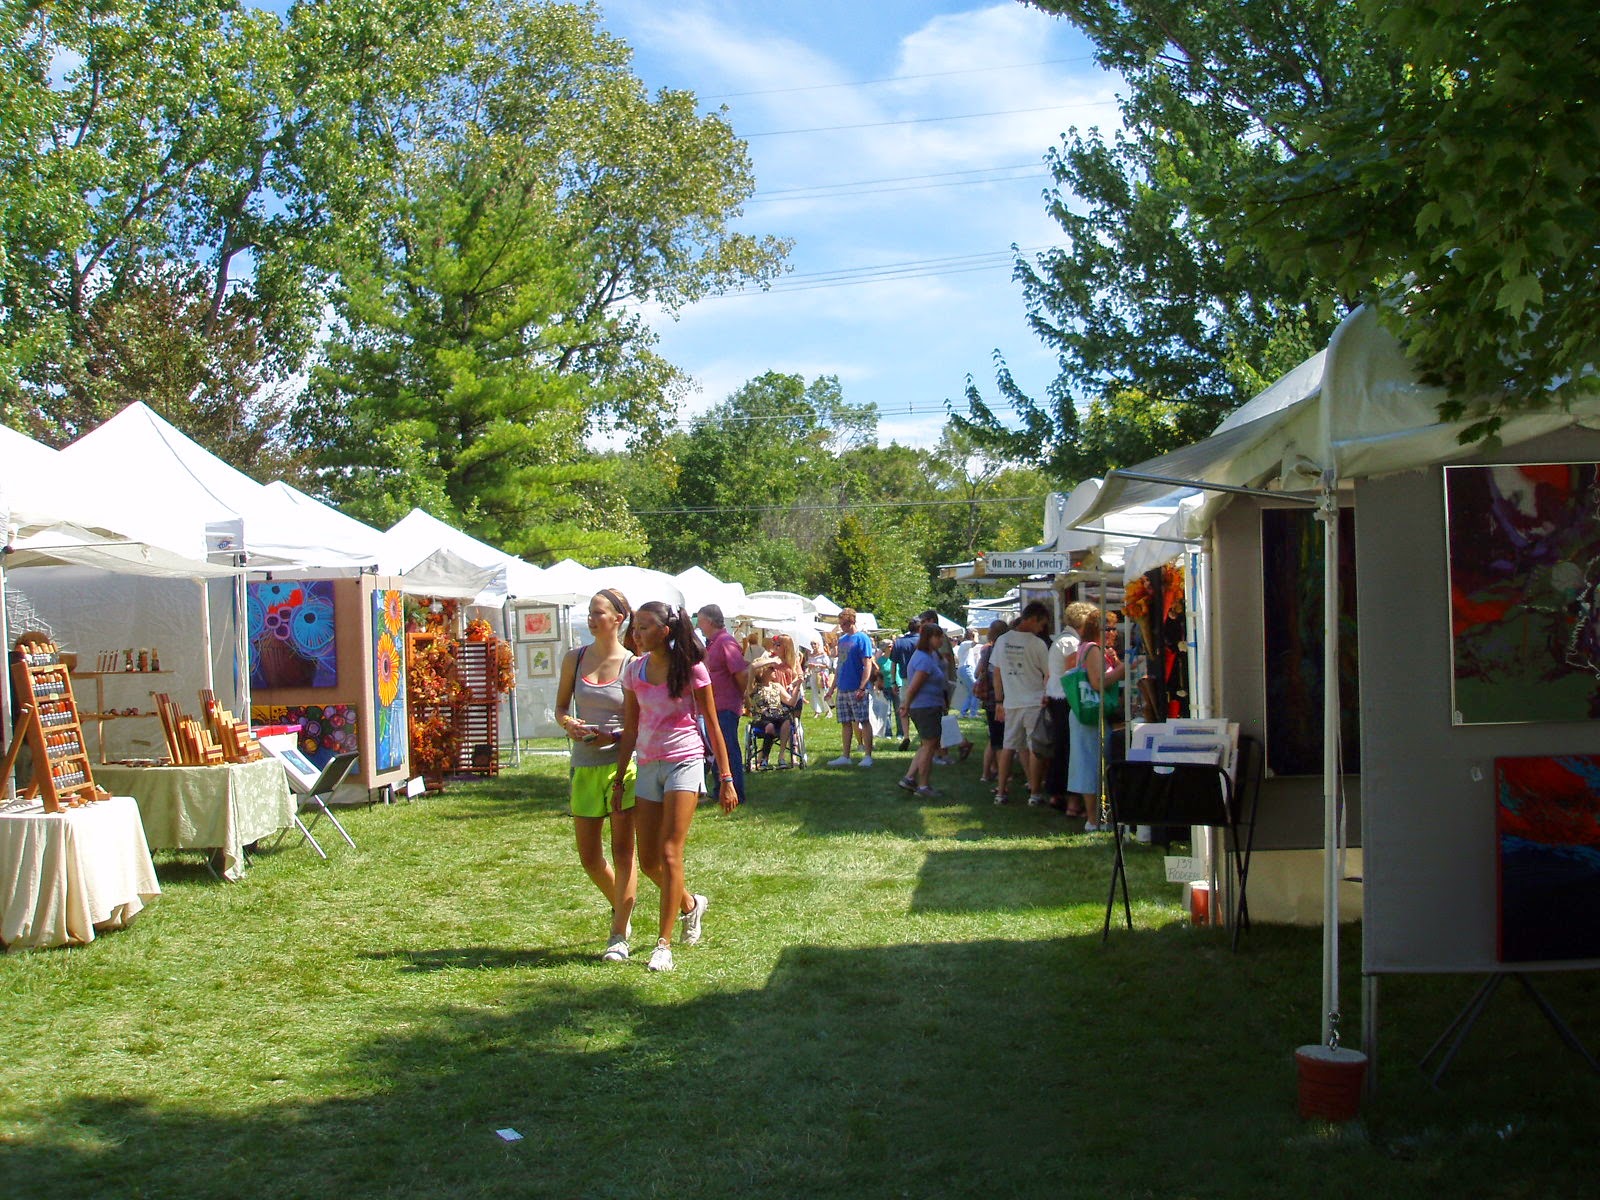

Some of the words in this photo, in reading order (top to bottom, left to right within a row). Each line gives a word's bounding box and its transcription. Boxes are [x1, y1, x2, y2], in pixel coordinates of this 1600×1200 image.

[992, 559, 1002, 569] On
[1004, 559, 1016, 569] The
[1018, 559, 1034, 570] Spot
[1036, 559, 1063, 570] Jewelry
